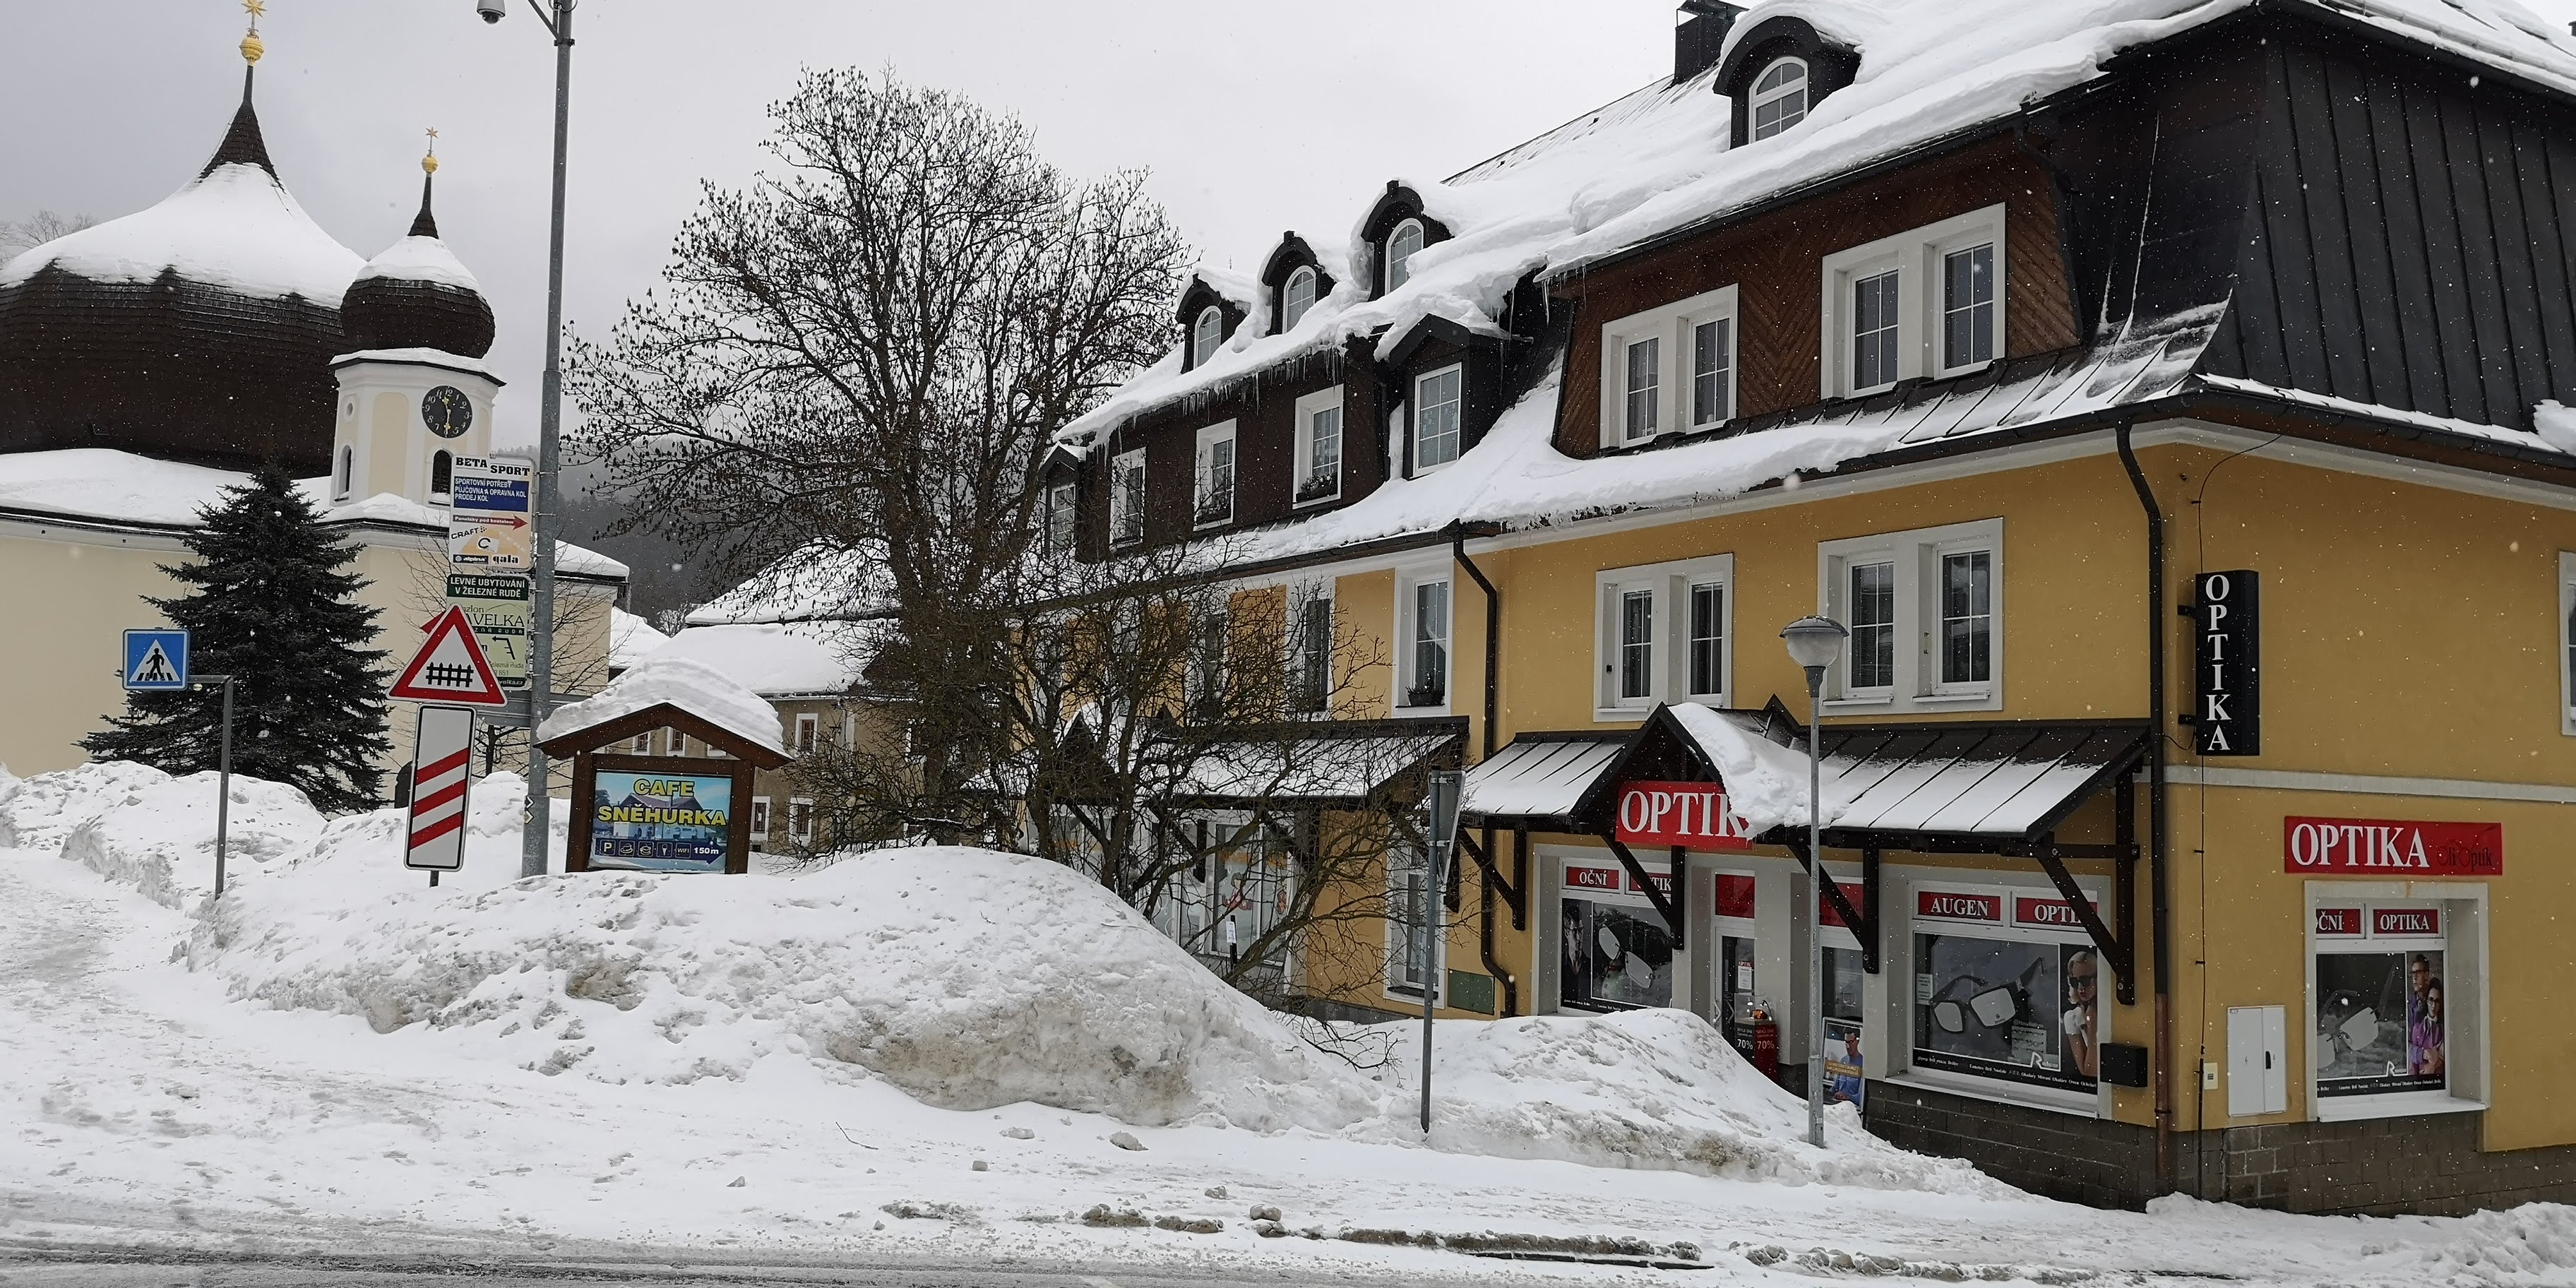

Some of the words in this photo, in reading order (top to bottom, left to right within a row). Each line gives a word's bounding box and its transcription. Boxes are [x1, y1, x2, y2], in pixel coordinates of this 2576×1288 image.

[445, 388, 453, 396] 12
[460, 400, 467, 409] 2
[455, 457, 488, 468] BETA
[490, 465, 530, 476] SPORT
[455, 477, 486, 486] SPORTOVNÍ
[487, 479, 513, 489] POTŘEBY
[455, 484, 484, 494] PŮJČOVNA
[451, 527, 479, 539] CRAFT
[451, 577, 477, 585] LEVNÉ
[478, 578, 525, 588] UBYTOVÁNÍ
[462, 585, 497, 597] ŽELEZNÉ
[499, 589, 521, 598] RUDĚ
[467, 613, 525, 627] VELKA
[2205, 574, 2232, 751] OPTIKA
[633, 778, 696, 797] CAFE
[597, 803, 727, 826] SNĚHURKA
[1621, 790, 1748, 837] OPTIK
[604, 842, 613, 852] P
[2291, 823, 2430, 868] OPTIKA
[1579, 869, 1607, 886] OČNÍ
[1931, 898, 1989, 917] AUGEN
[2034, 905, 2082, 924] OPTI
[2315, 910, 2343, 931] ČNÍ
[2380, 914, 2429, 931] OPTIKA
[1737, 1039, 1753, 1050] 70%
[1757, 1040, 1775, 1050] 70%
